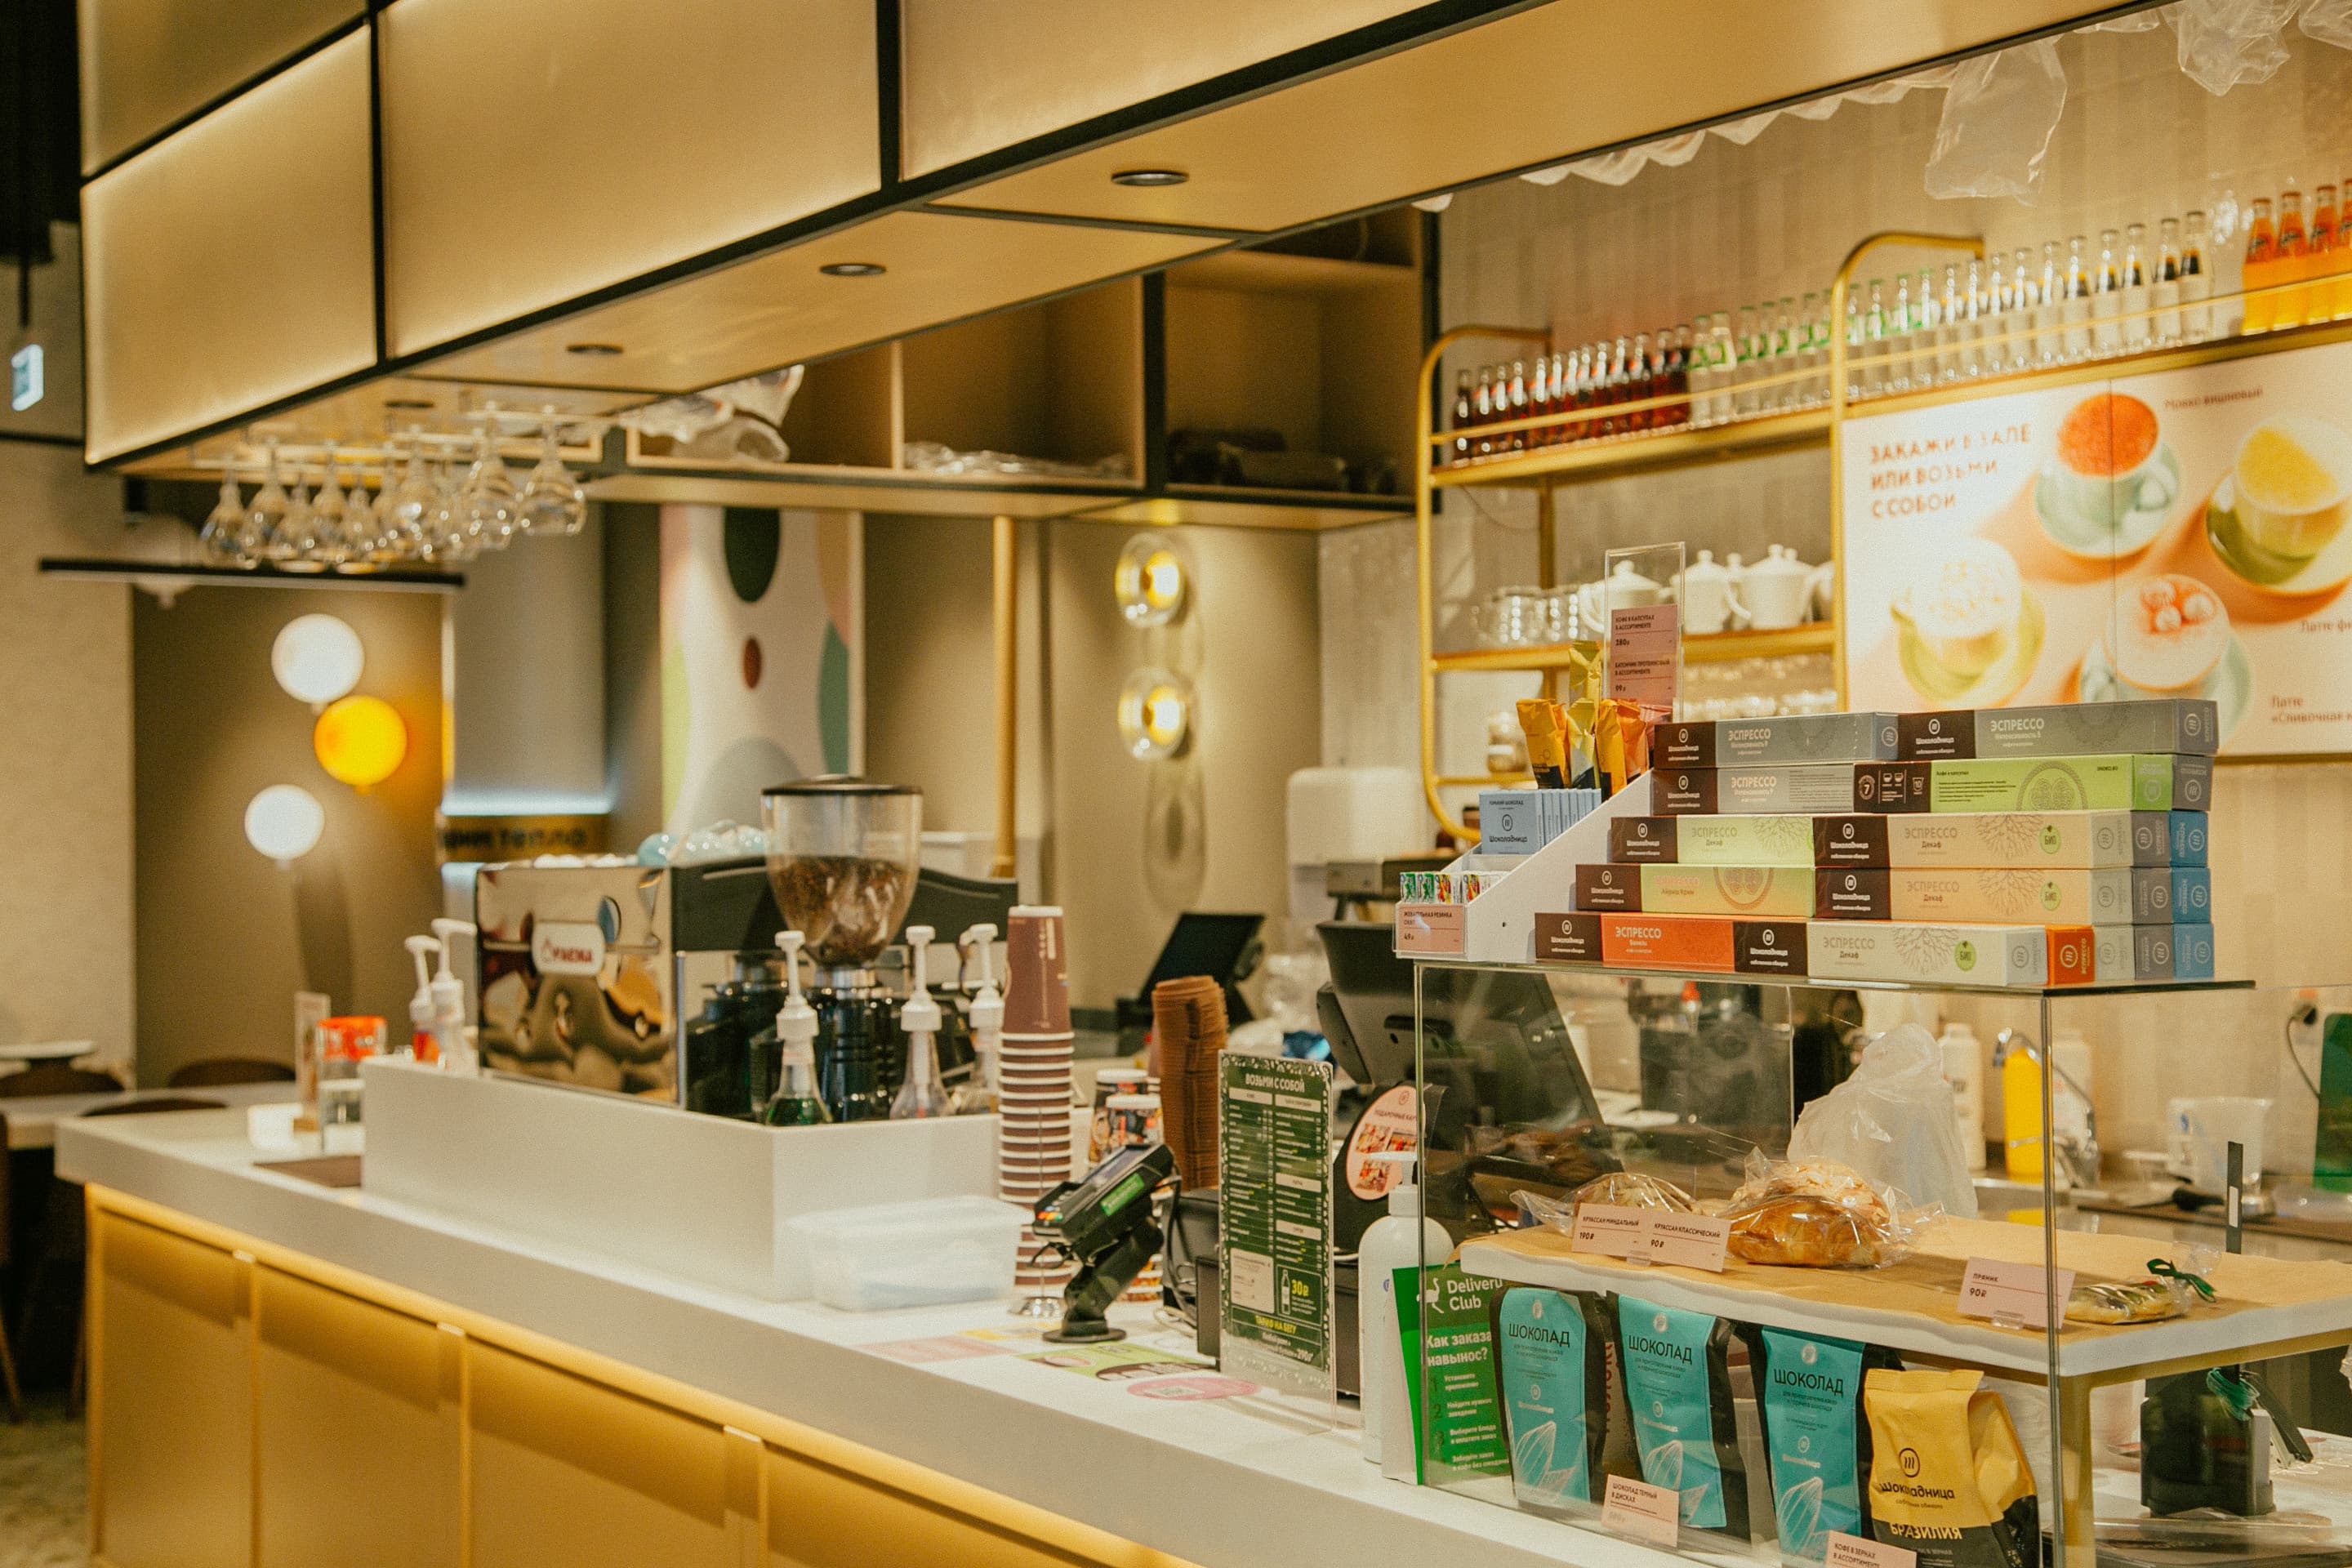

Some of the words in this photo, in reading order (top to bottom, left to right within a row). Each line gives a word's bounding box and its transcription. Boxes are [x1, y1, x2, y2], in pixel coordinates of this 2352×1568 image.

[1870, 437, 1956, 465] ЗАКАЖИ
[1980, 423, 2030, 447] ЗАЛЕ
[1871, 470, 1910, 490] ИЛИ
[1871, 499, 1882, 519] С
[1990, 718, 2045, 733] ЭСПРЕССО
[1728, 728, 1771, 742] ЭСПРЕССО
[1731, 776, 1776, 788] ЭСПРЕССО
[1864, 784, 1870, 795] 7
[1691, 826, 1738, 838] ЭСПРЕССО
[1904, 827, 1958, 840] ЭСПРЕССО
[1922, 840, 1942, 849] Декаф
[2044, 835, 2057, 845] БИО
[1907, 881, 1960, 893] ЭСПРЕССО
[1923, 894, 1944, 902] Декаф
[1615, 926, 1662, 938] ЭСПРЕССО
[1823, 937, 1876, 950] ЭСПРЕССО
[1839, 951, 1860, 960] Декаф
[1959, 951, 1972, 961] БИО
[1245, 1073, 1274, 1088] ВОЗЬМИ
[1280, 1078, 1305, 1093] СОБОЙ
[1583, 1216, 1606, 1224] КРУАССАН
[1655, 1223, 1677, 1232] КРУАССАН
[1678, 1226, 1721, 1239] КЛАССИЧЕСКИЙ
[1973, 1273, 1999, 1282] ПРЯНИК
[1449, 1294, 1482, 1311] Club
[1426, 1334, 1450, 1349] Как
[1451, 1331, 1492, 1346] заказа
[1509, 1323, 1570, 1348] ШОКОЛАД
[1427, 1346, 1488, 1367] навынос?
[1628, 1335, 1693, 1365] ШОКОЛАД
[1774, 1369, 1844, 1398] ШОКОЛАД
[1613, 1482, 1639, 1495] ШОКОЛАД
[1879, 1482, 1955, 1499] Шокадница
[1615, 1493, 1636, 1503] ДИСКАХ
[1890, 1523, 1962, 1540] БРАЗИЛИЯ
[1834, 1543, 1850, 1552] КОФЕ
[1855, 1548, 1876, 1559] ЗЕРНАХ
